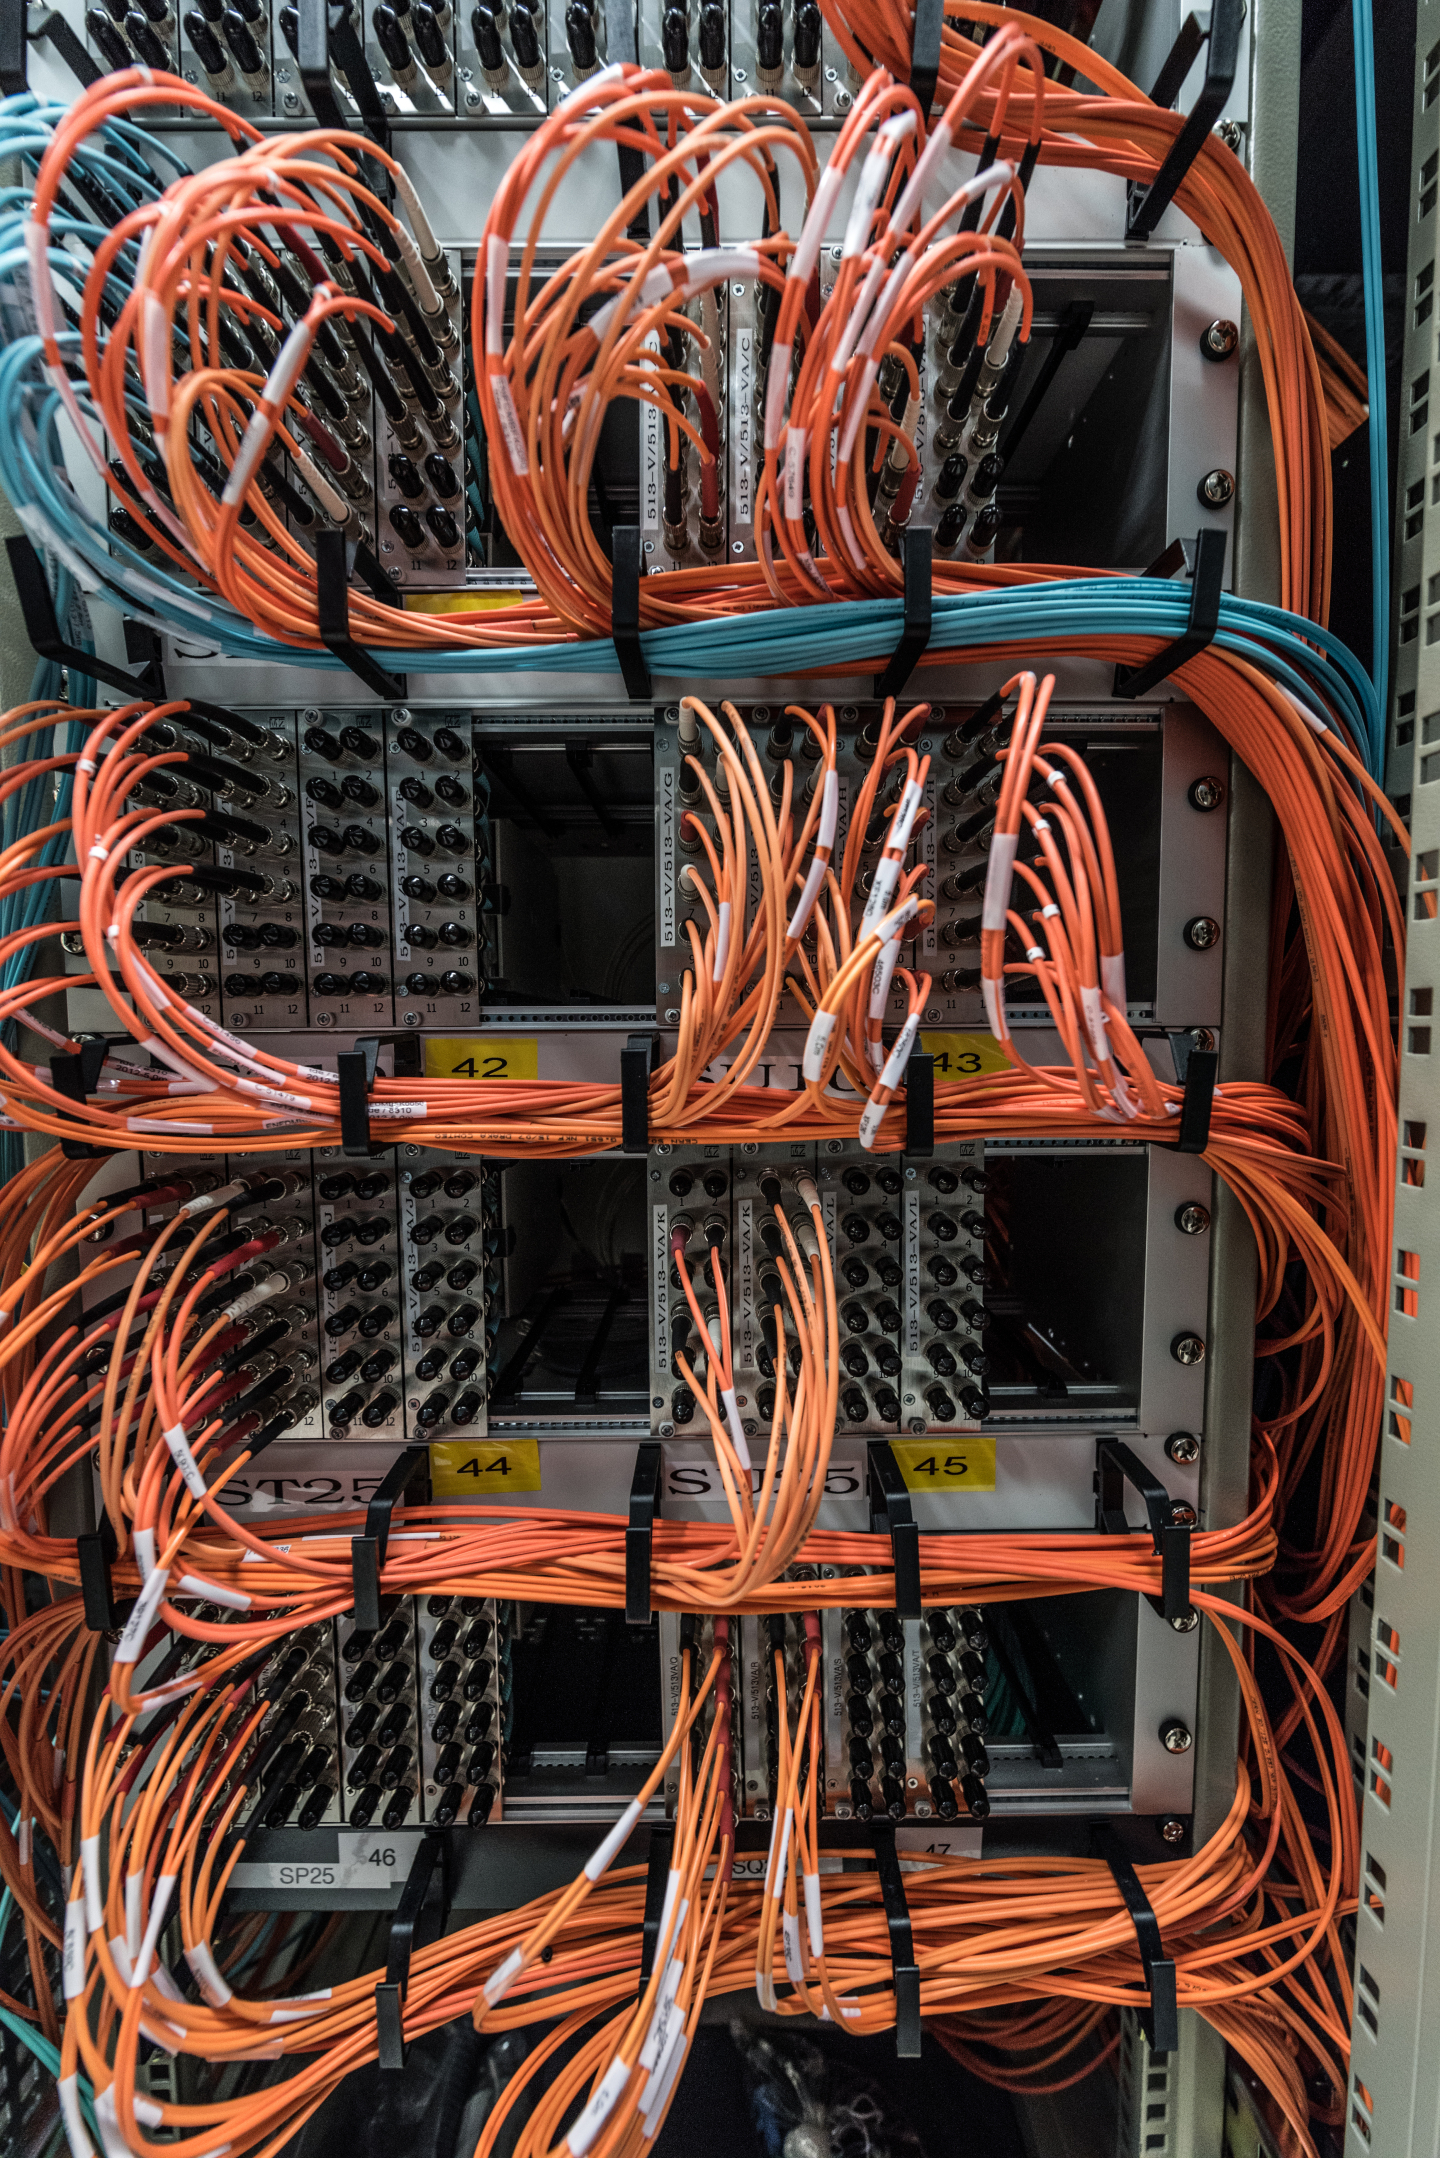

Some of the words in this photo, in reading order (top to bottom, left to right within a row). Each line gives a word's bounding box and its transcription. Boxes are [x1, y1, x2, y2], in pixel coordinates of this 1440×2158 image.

[740, 336, 750, 515] 513-V/513-VA/C
[411, 560, 422, 570] 11
[446, 560, 457, 570] 12
[280, 772, 286, 782] 2
[366, 770, 372, 780] 2
[280, 818, 287, 828] 4
[334, 818, 340, 827] 3
[367, 817, 373, 827] 4
[421, 818, 428, 828] 3
[455, 817, 461, 827] 4
[950, 816, 956, 825] 3
[664, 772, 674, 942] 513-V/513-VA/G
[283, 866, 290, 875] 6
[337, 865, 343, 874] 5
[370, 864, 376, 873] 6
[424, 864, 430, 873] 5
[457, 864, 464, 873] 6
[950, 862, 956, 871] 5
[165, 913, 171, 922] 7
[199, 912, 205, 922] 8
[252, 913, 258, 922] 7
[285, 912, 292, 921] 8
[338, 911, 344, 920] 7
[371, 911, 378, 920] 8
[425, 911, 431, 920] 7
[459, 911, 465, 920] 8
[950, 908, 956, 917] 7
[285, 958, 296, 968] 10
[340, 957, 346, 967] 9
[371, 956, 382, 966] 10
[427, 957, 433, 966] 9
[458, 956, 469, 966] 10
[950, 954, 956, 963] 9
[167, 959, 173, 969] 9
[198, 959, 209, 969] 10
[254, 959, 260, 969] 9
[201, 1005, 212, 1014] 12
[254, 1005, 264, 1014] 11
[287, 1004, 298, 1014] 12
[340, 1003, 350, 1013] 11
[373, 1003, 384, 1013] 12
[426, 1003, 437, 1013] 11
[460, 1002, 471, 1013] 12
[451, 1057, 508, 1078] 42
[933, 1052, 982, 1073] 43
[379, 1200, 385, 1209] 2
[463, 1198, 469, 1208] 2
[967, 1195, 973, 1205] 2
[348, 1243, 354, 1253] 3
[379, 1243, 386, 1252] 4
[432, 1242, 438, 1252] 3
[464, 1243, 471, 1252] 4
[933, 1239, 940, 1249] 3
[965, 1239, 972, 1247] 4
[909, 1196, 918, 1352] 513-V/513-VA/L
[742, 1205, 752, 1363] 513-V/513-VA/K
[934, 1282, 940, 1292] 5
[966, 1283, 972, 1292] 6
[350, 1287, 356, 1297] 5
[381, 1287, 388, 1296] 6
[434, 1286, 440, 1296] 5
[466, 1286, 473, 1296] 6
[657, 1211, 667, 1369] 513-V/513-VA/K
[383, 1331, 390, 1340] 8
[383, 1374, 393, 1384] 10
[304, 1416, 314, 1426] 12
[353, 1416, 363, 1426] 11
[385, 1416, 395, 1426] 12
[457, 1456, 512, 1478] 44
[913, 1456, 968, 1476] 45
[368, 1848, 396, 1867] 46
[279, 1867, 335, 1885] SP25
